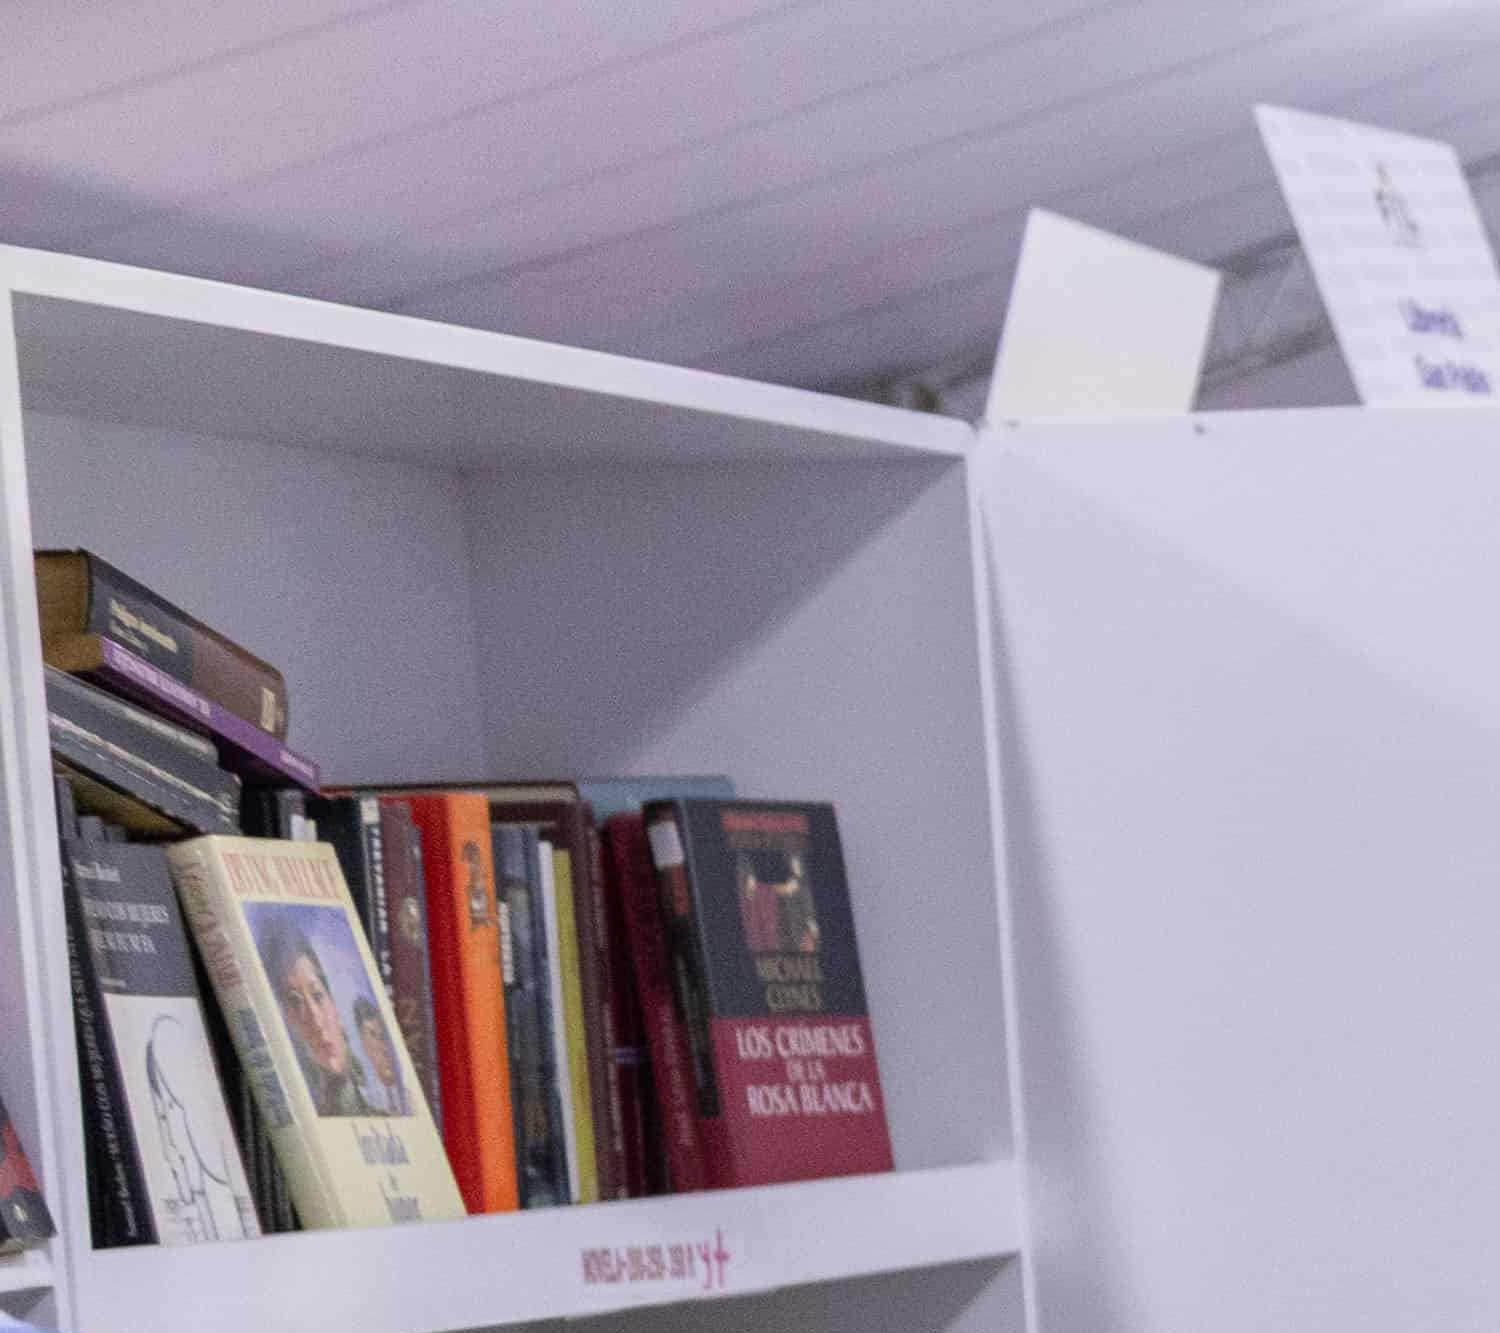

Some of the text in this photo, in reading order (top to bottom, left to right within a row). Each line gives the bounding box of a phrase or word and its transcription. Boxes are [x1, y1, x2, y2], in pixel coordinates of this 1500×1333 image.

[736, 1026, 772, 1058] LOS
[747, 1082, 872, 1116] ROSA BLANCA
